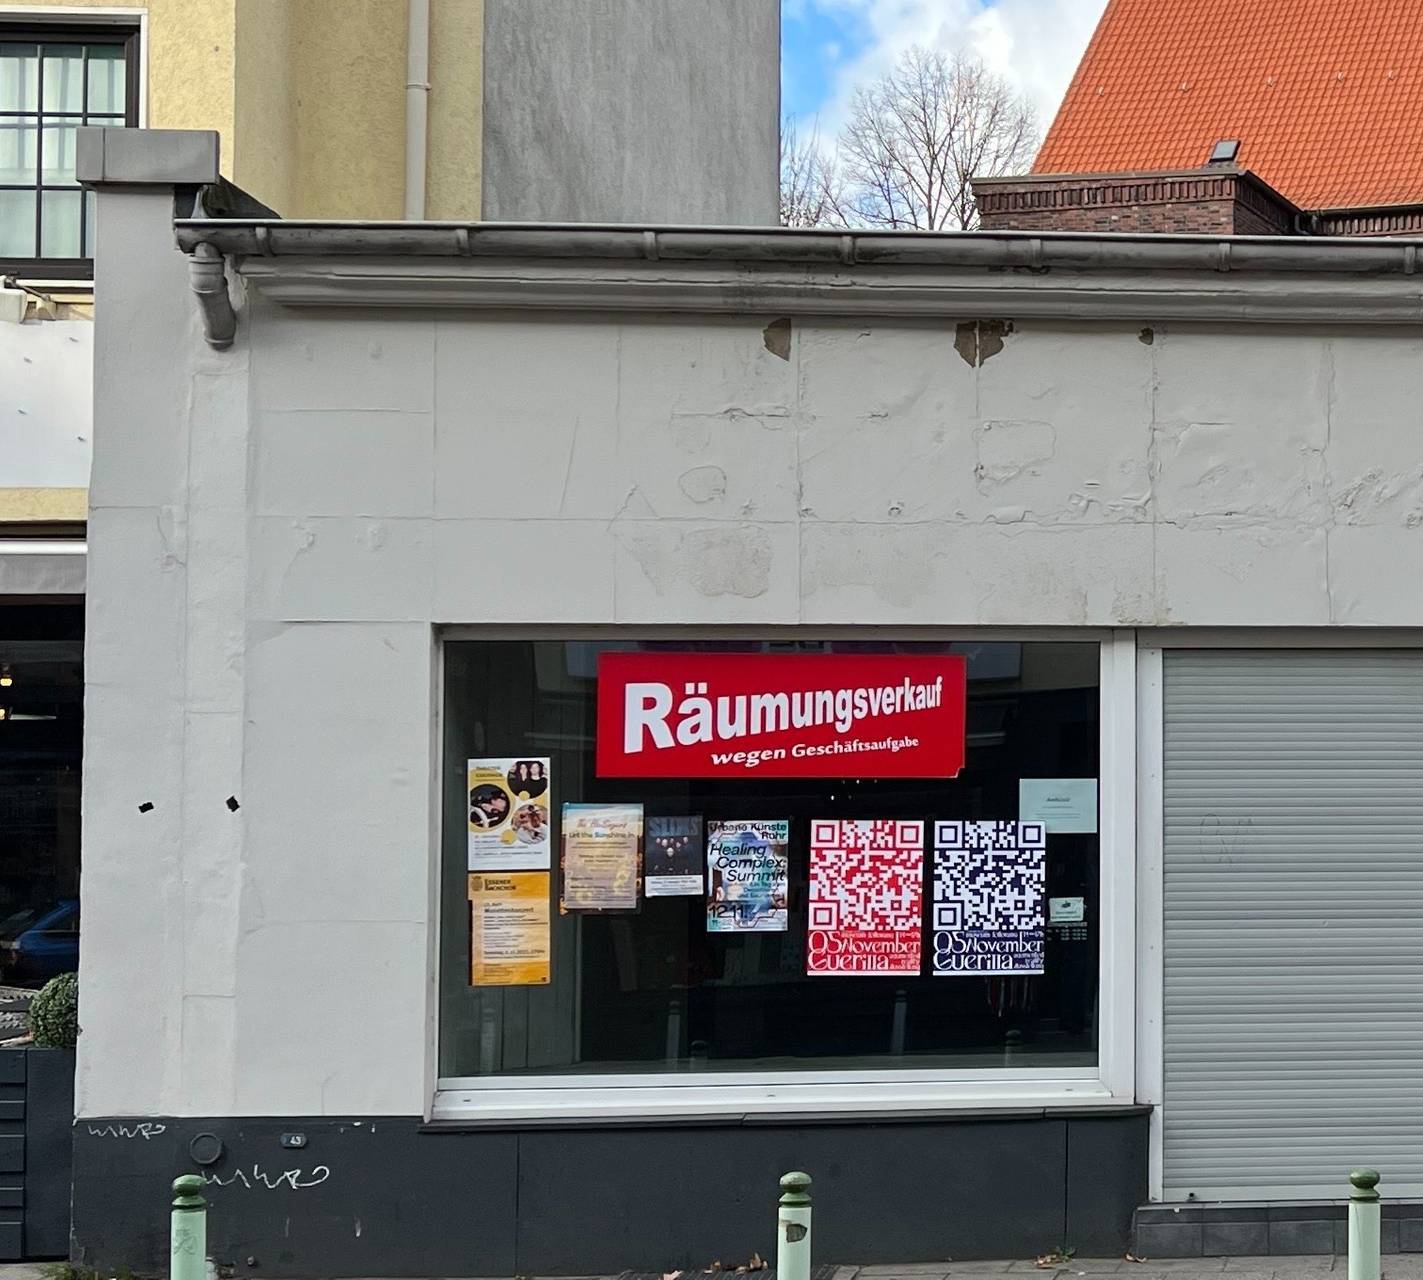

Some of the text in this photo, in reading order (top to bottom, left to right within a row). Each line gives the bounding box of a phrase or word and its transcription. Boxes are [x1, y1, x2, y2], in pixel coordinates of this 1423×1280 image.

[624, 676, 943, 754] Räumungsverkauf
[711, 736, 919, 768] wegen Geschäftsaufgabe
[710, 843, 767, 859] Healing
[717, 857, 783, 871] Complex
[727, 869, 785, 882] Summit
[841, 931, 921, 954] November
[965, 931, 1045, 954] November
